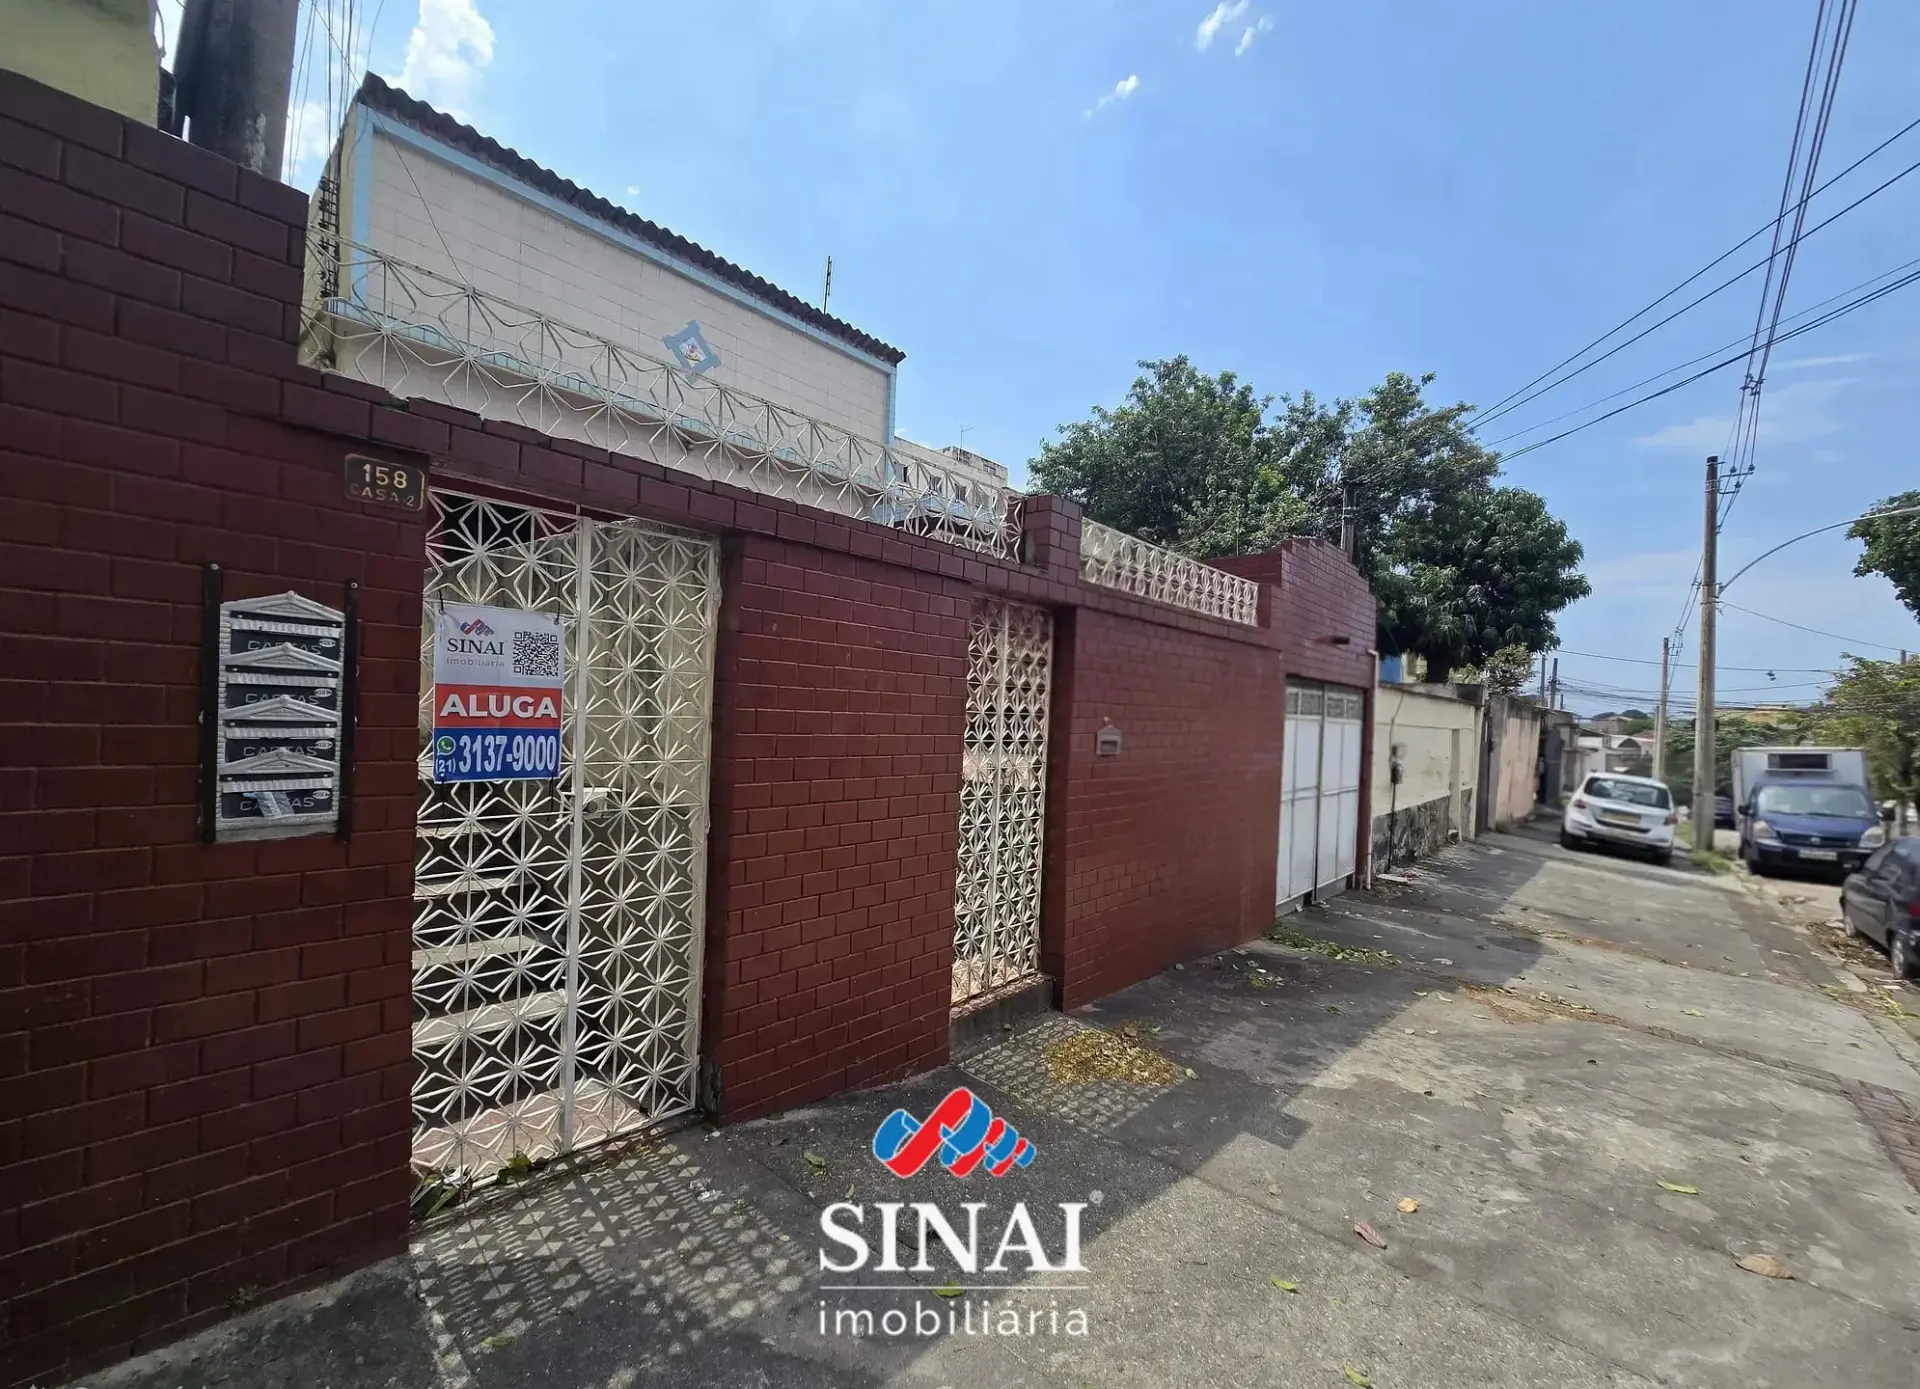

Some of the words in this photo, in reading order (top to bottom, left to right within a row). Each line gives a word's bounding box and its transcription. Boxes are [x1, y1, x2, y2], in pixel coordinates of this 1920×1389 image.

[363, 463, 407, 489] 158
[447, 638, 505, 656] SINAI
[439, 694, 559, 719] ALUGA
[435, 758, 456, 774] (21)
[458, 735, 556, 773] 3137-9000
